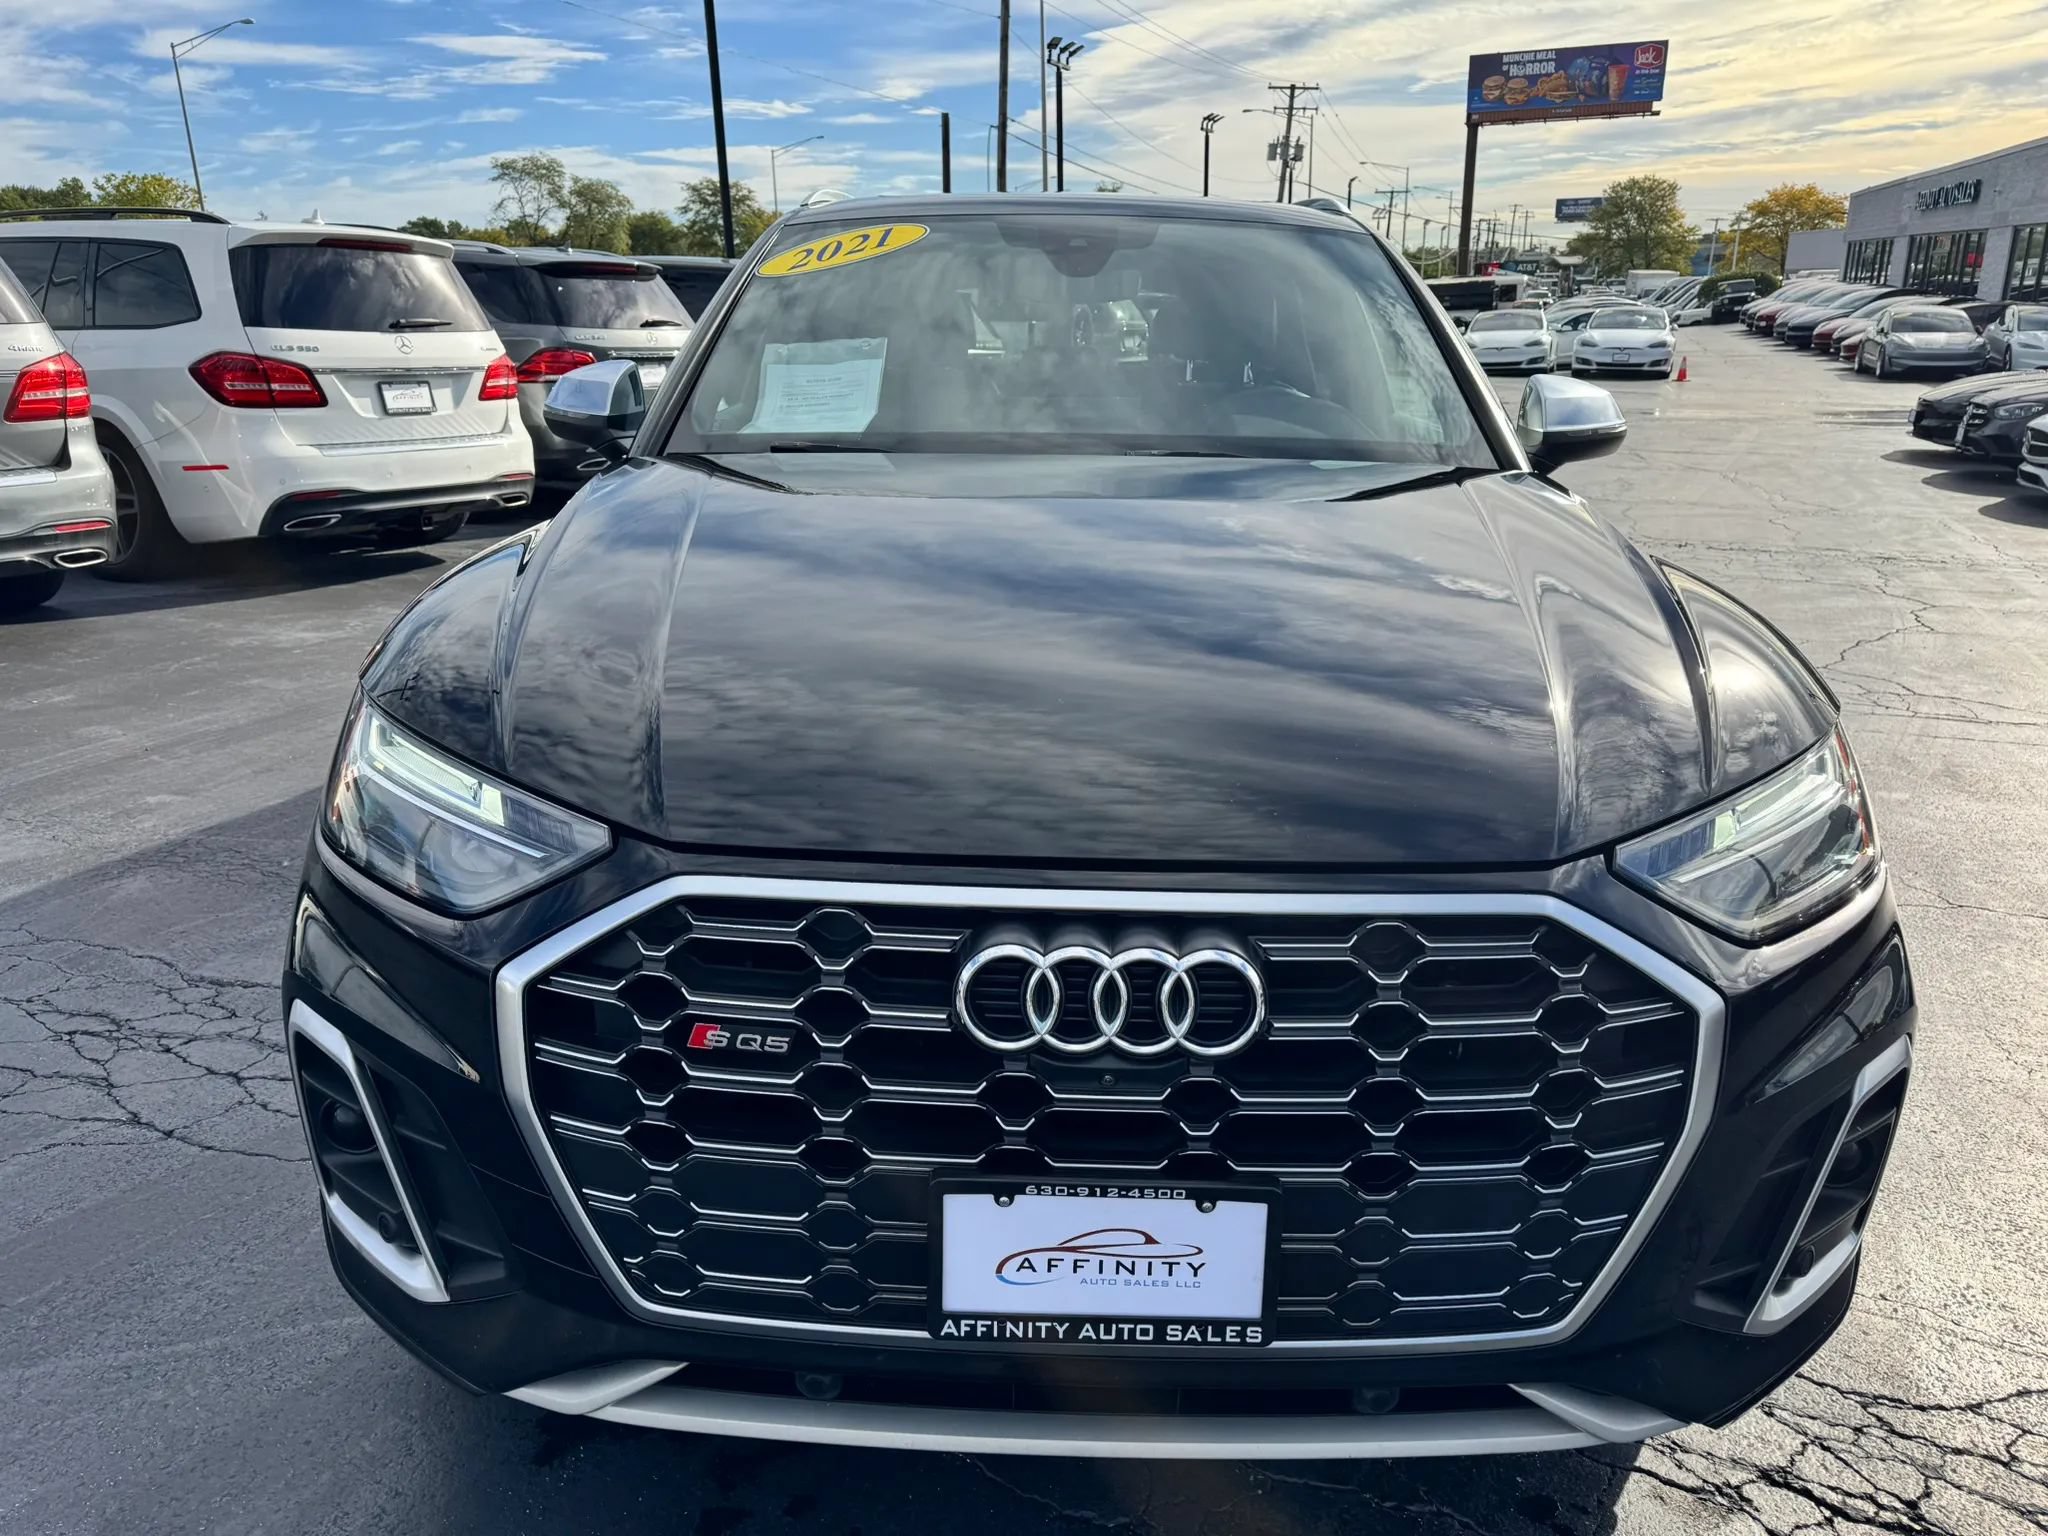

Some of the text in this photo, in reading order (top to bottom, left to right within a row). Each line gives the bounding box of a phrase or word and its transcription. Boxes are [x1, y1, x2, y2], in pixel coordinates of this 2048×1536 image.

[1502, 50, 1556, 63] MUNCHIE MEAL
[1636, 46, 1661, 65] Jack
[1509, 61, 1556, 77] HORROR
[788, 227, 894, 272] 2021
[1516, 263, 1537, 271] AT&T
[704, 1030, 791, 1052] SQ5
[1026, 1185, 1187, 1199] 630-912-4500
[1015, 1257, 1206, 1278] AFFINITY
[1080, 1278, 1201, 1289] AUTO SALES LLC
[940, 1319, 1263, 1343] AFFINITY AUTO SALES
